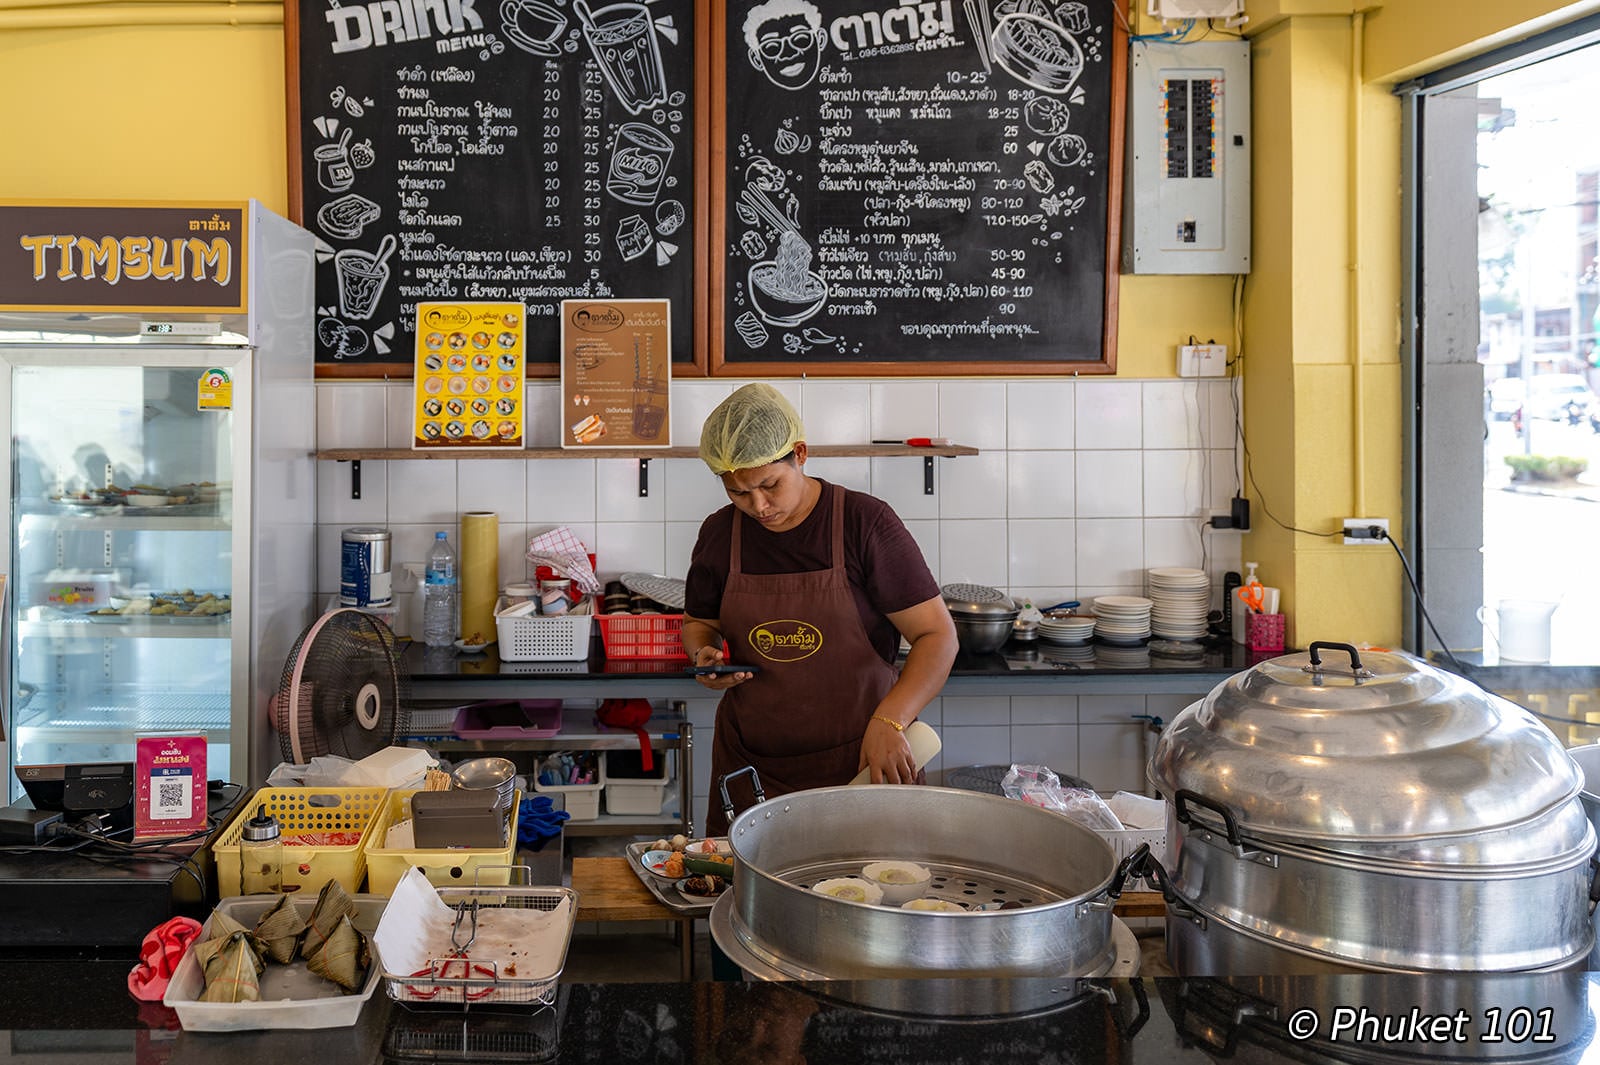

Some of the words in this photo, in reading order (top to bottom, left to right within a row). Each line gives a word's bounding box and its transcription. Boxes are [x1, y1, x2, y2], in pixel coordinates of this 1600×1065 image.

[325, 0, 484, 54] DRINK
[397, 65, 427, 81] ชาดำ
[544, 71, 560, 83] 20
[586, 71, 602, 84] 25
[397, 85, 429, 99] ชานม
[544, 89, 560, 101] 20
[585, 89, 603, 103] 25
[1007, 89, 1036, 101] 18-20
[397, 100, 470, 117] กาแฟโบราณ
[543, 106, 559, 119] 20
[584, 107, 602, 119] 25
[987, 107, 1019, 119] 18-25
[398, 119, 469, 137] กาแฟโบราณ
[543, 125, 560, 138] 20
[584, 125, 600, 138] 25
[1003, 125, 1019, 137] 25
[544, 142, 558, 154] 20
[584, 142, 600, 155] 25
[1003, 142, 1018, 154] 60
[397, 157, 455, 171] เนสกาแฟ
[544, 161, 559, 172] 20
[584, 162, 600, 173] 25
[619, 154, 659, 174] MILO
[397, 172, 446, 189] ชามะนาว
[545, 178, 560, 190] 20
[584, 180, 601, 192] 25
[993, 179, 1026, 191] 70-90
[398, 191, 429, 208] ไมโล
[545, 196, 560, 208] 20
[584, 198, 601, 209] 25
[981, 197, 1024, 209] 80-120
[546, 215, 561, 227] 25
[583, 215, 600, 226] 30
[983, 215, 1029, 226] 120-150
[584, 233, 601, 245] 25
[872, 232, 896, 245] บาท
[901, 232, 942, 249] ทุกเมนู
[20, 234, 232, 286] TIMSUM
[583, 250, 601, 263] 30
[990, 249, 1026, 261] 50-90
[590, 269, 600, 279] 5
[991, 268, 1026, 280] 45-90
[828, 299, 877, 316] อาหารเช้า
[999, 303, 1016, 314] 90
